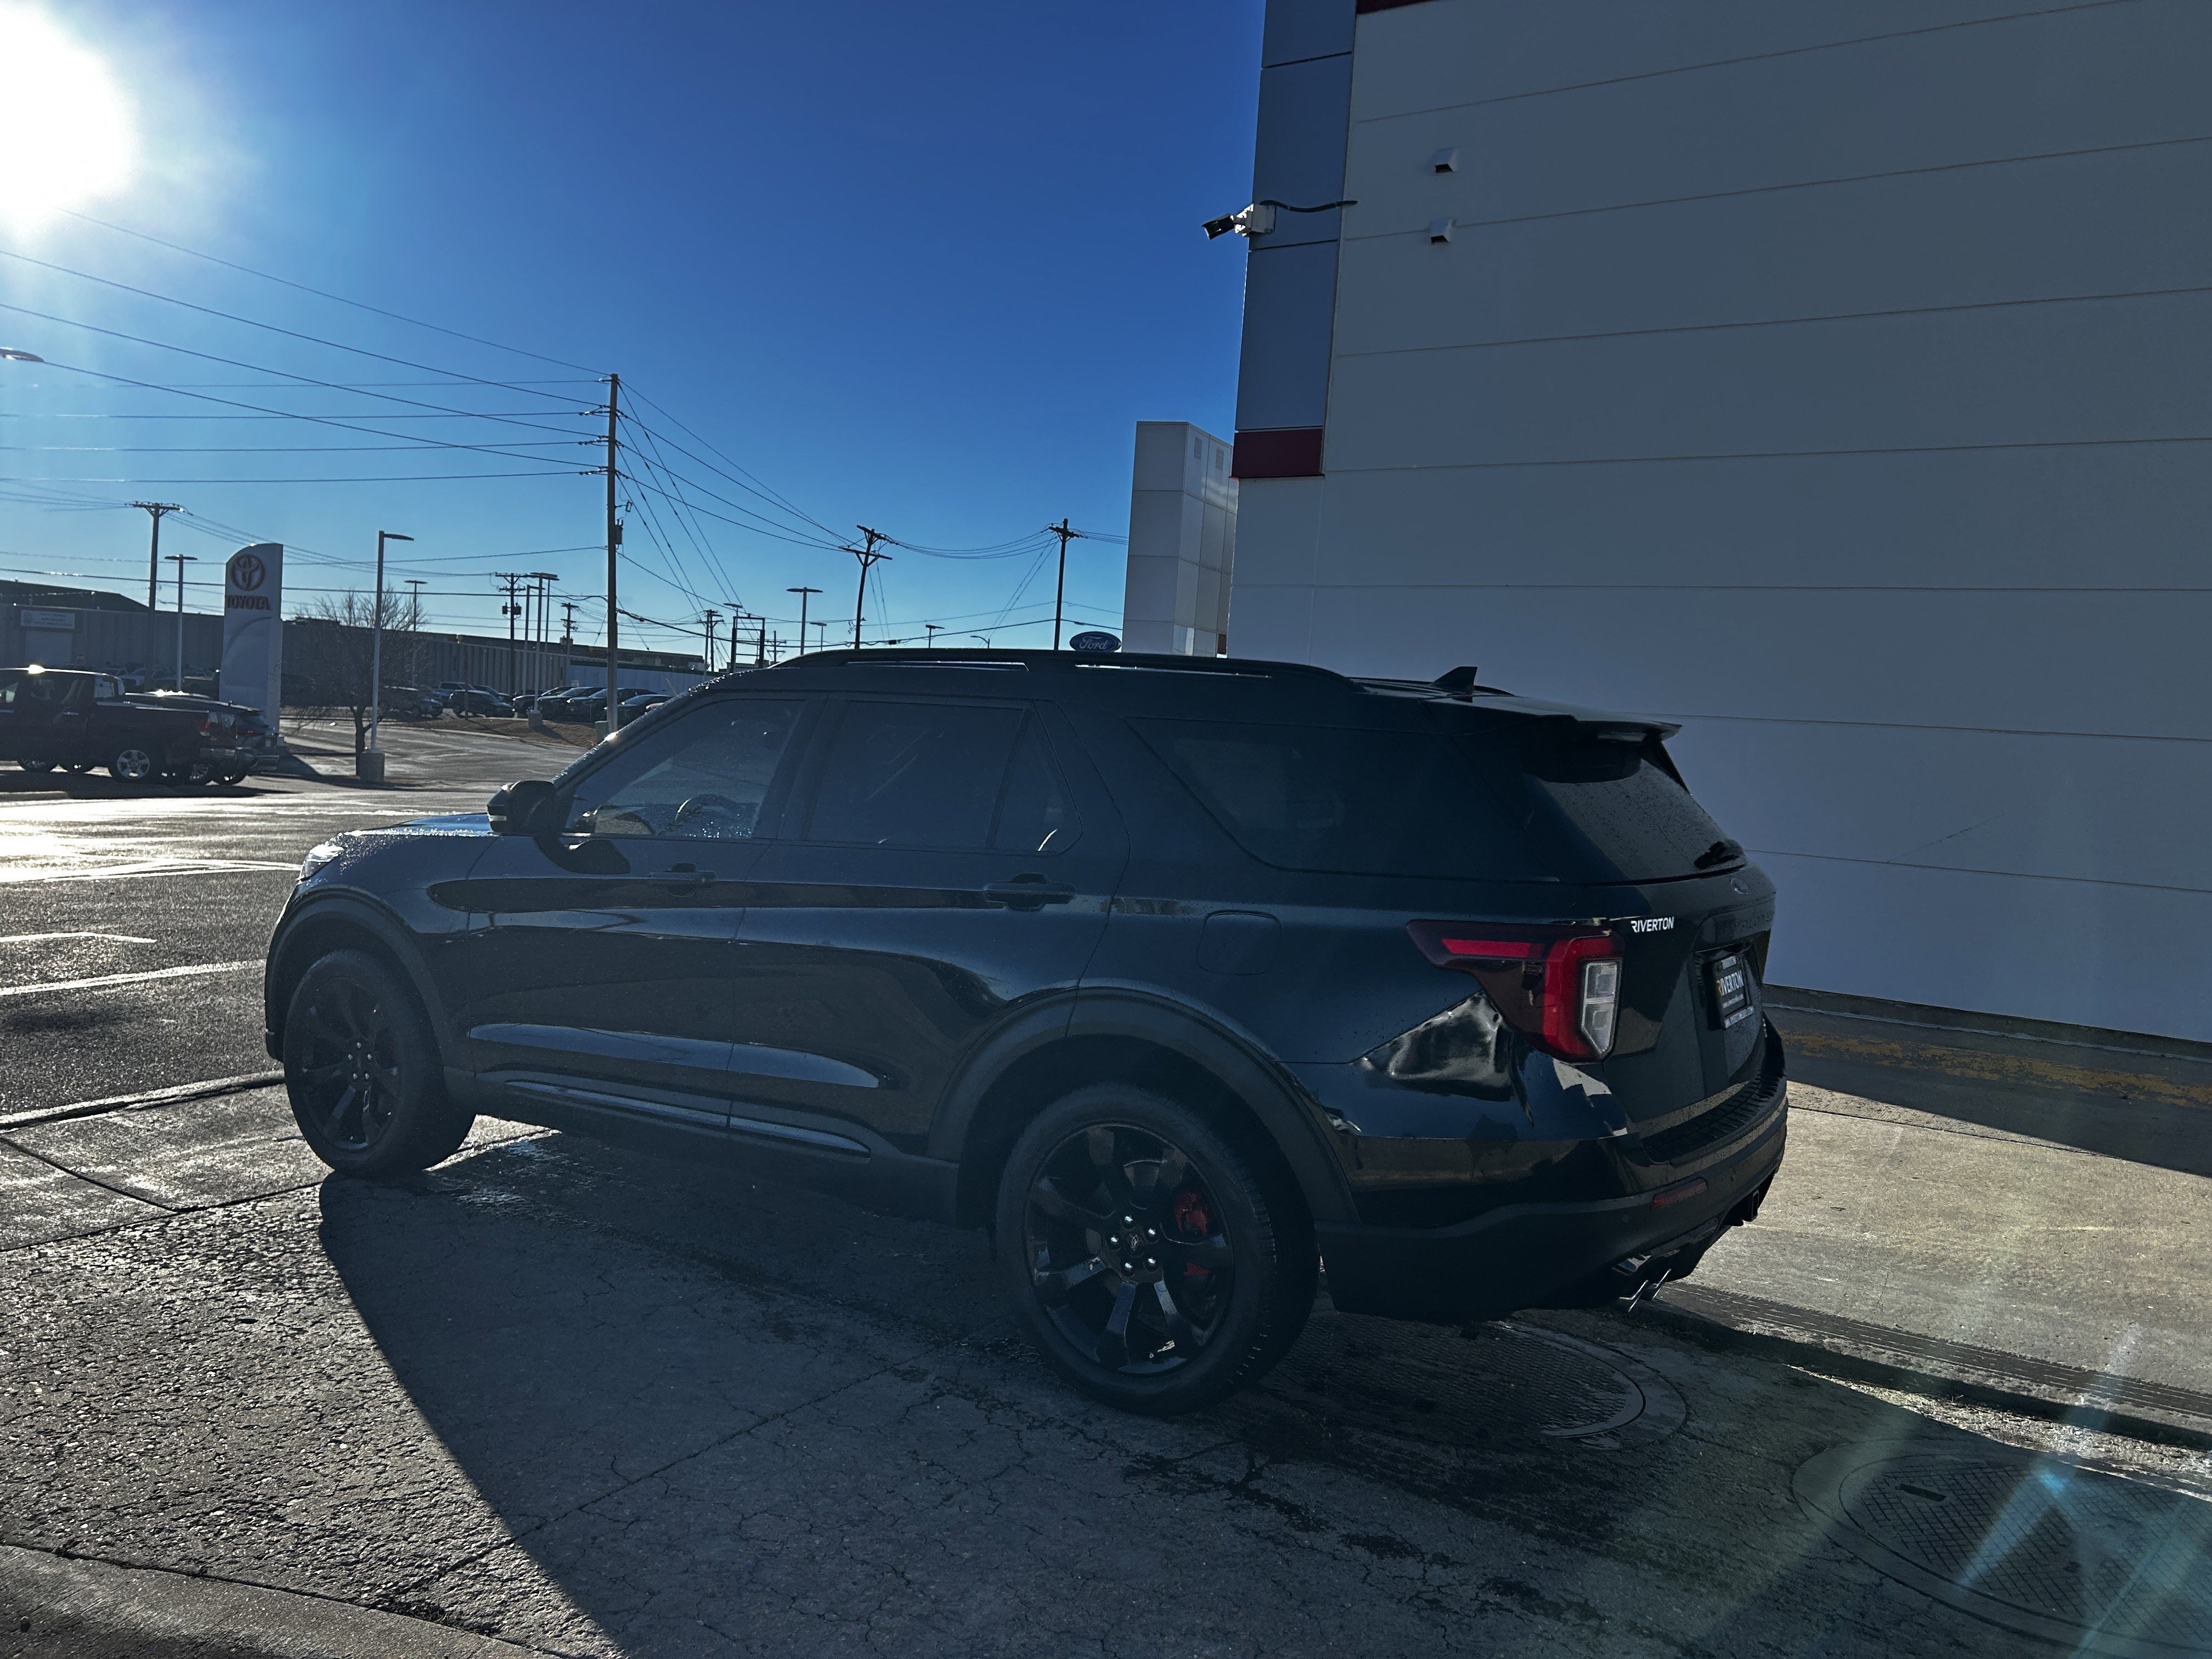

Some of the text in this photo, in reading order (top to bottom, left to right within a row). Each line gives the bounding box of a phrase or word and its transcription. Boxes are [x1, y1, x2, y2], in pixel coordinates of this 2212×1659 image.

[227, 595, 270, 610] TOYOTA
[1080, 635, 1108, 650] Ford
[1630, 917, 1674, 933] RIVERTON
[1717, 970, 1743, 996] RIVERTON
